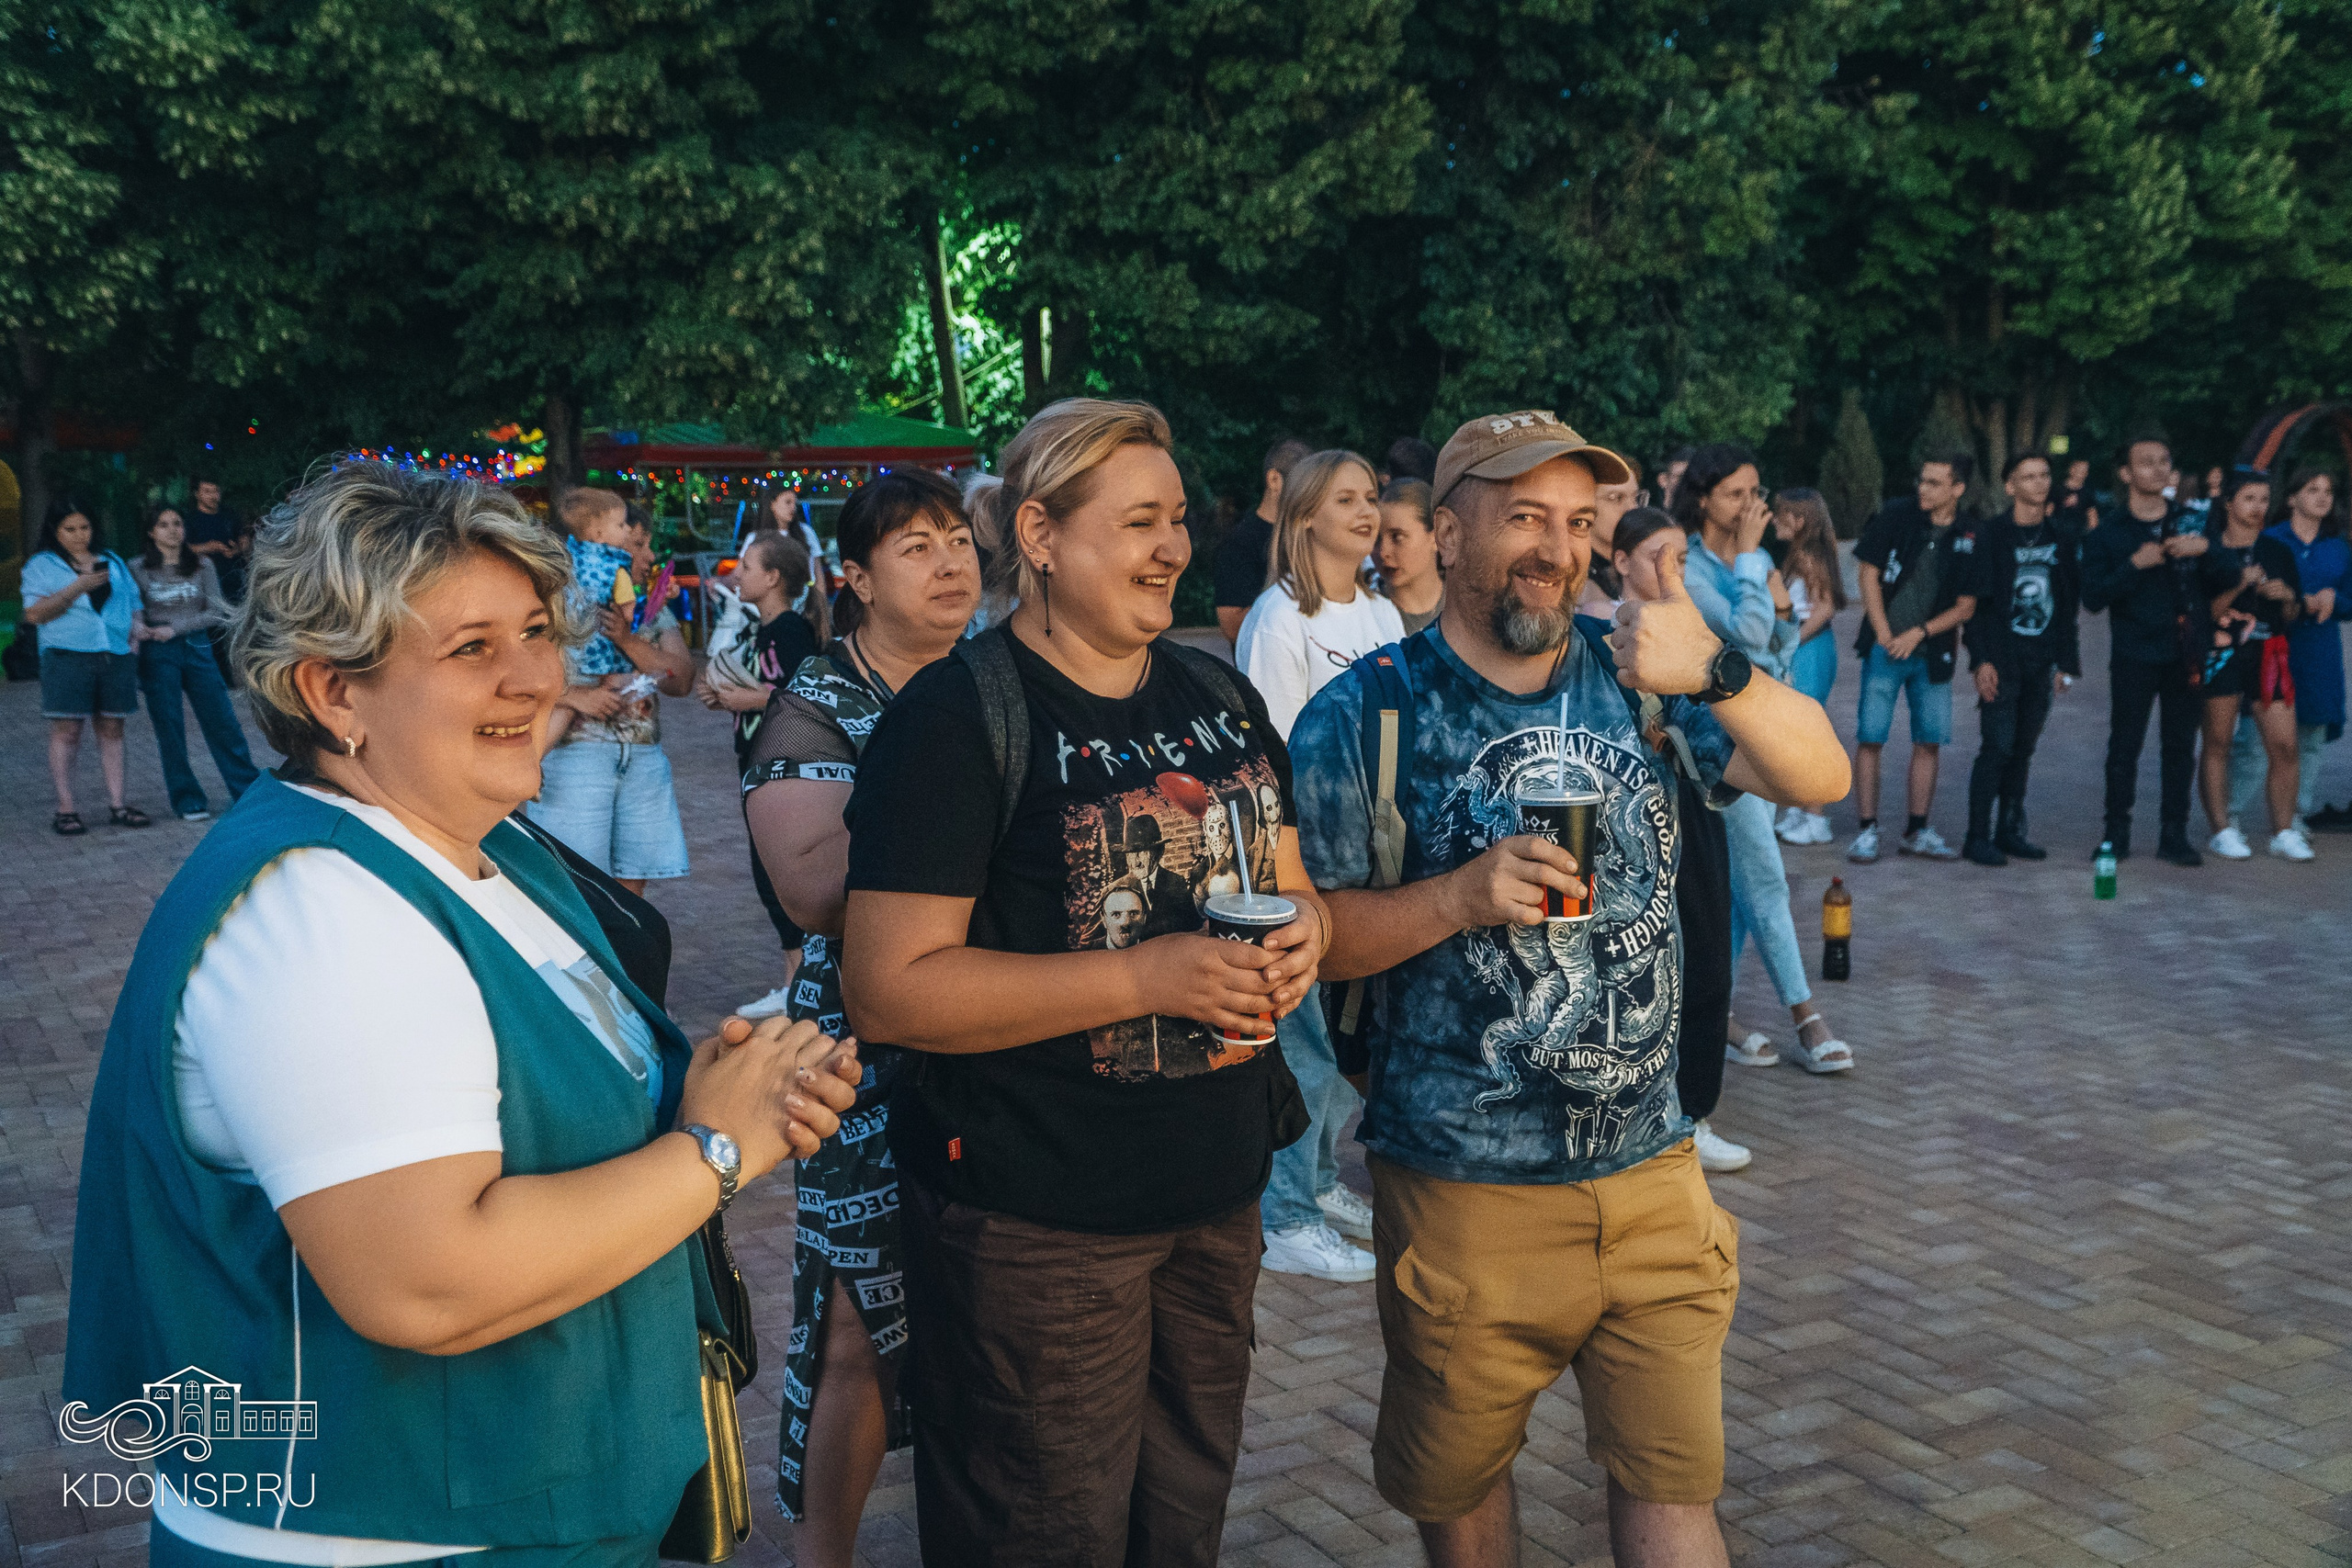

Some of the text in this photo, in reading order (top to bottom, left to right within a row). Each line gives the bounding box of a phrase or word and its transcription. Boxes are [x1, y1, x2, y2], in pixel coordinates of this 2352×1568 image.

[1536, 730, 1673, 958] HEAVEN IS GOOD ENOUGH
[1530, 1046, 1563, 1069] BUT
[1567, 1050, 1608, 1069] MOST
[1644, 1045, 1670, 1077] THE
